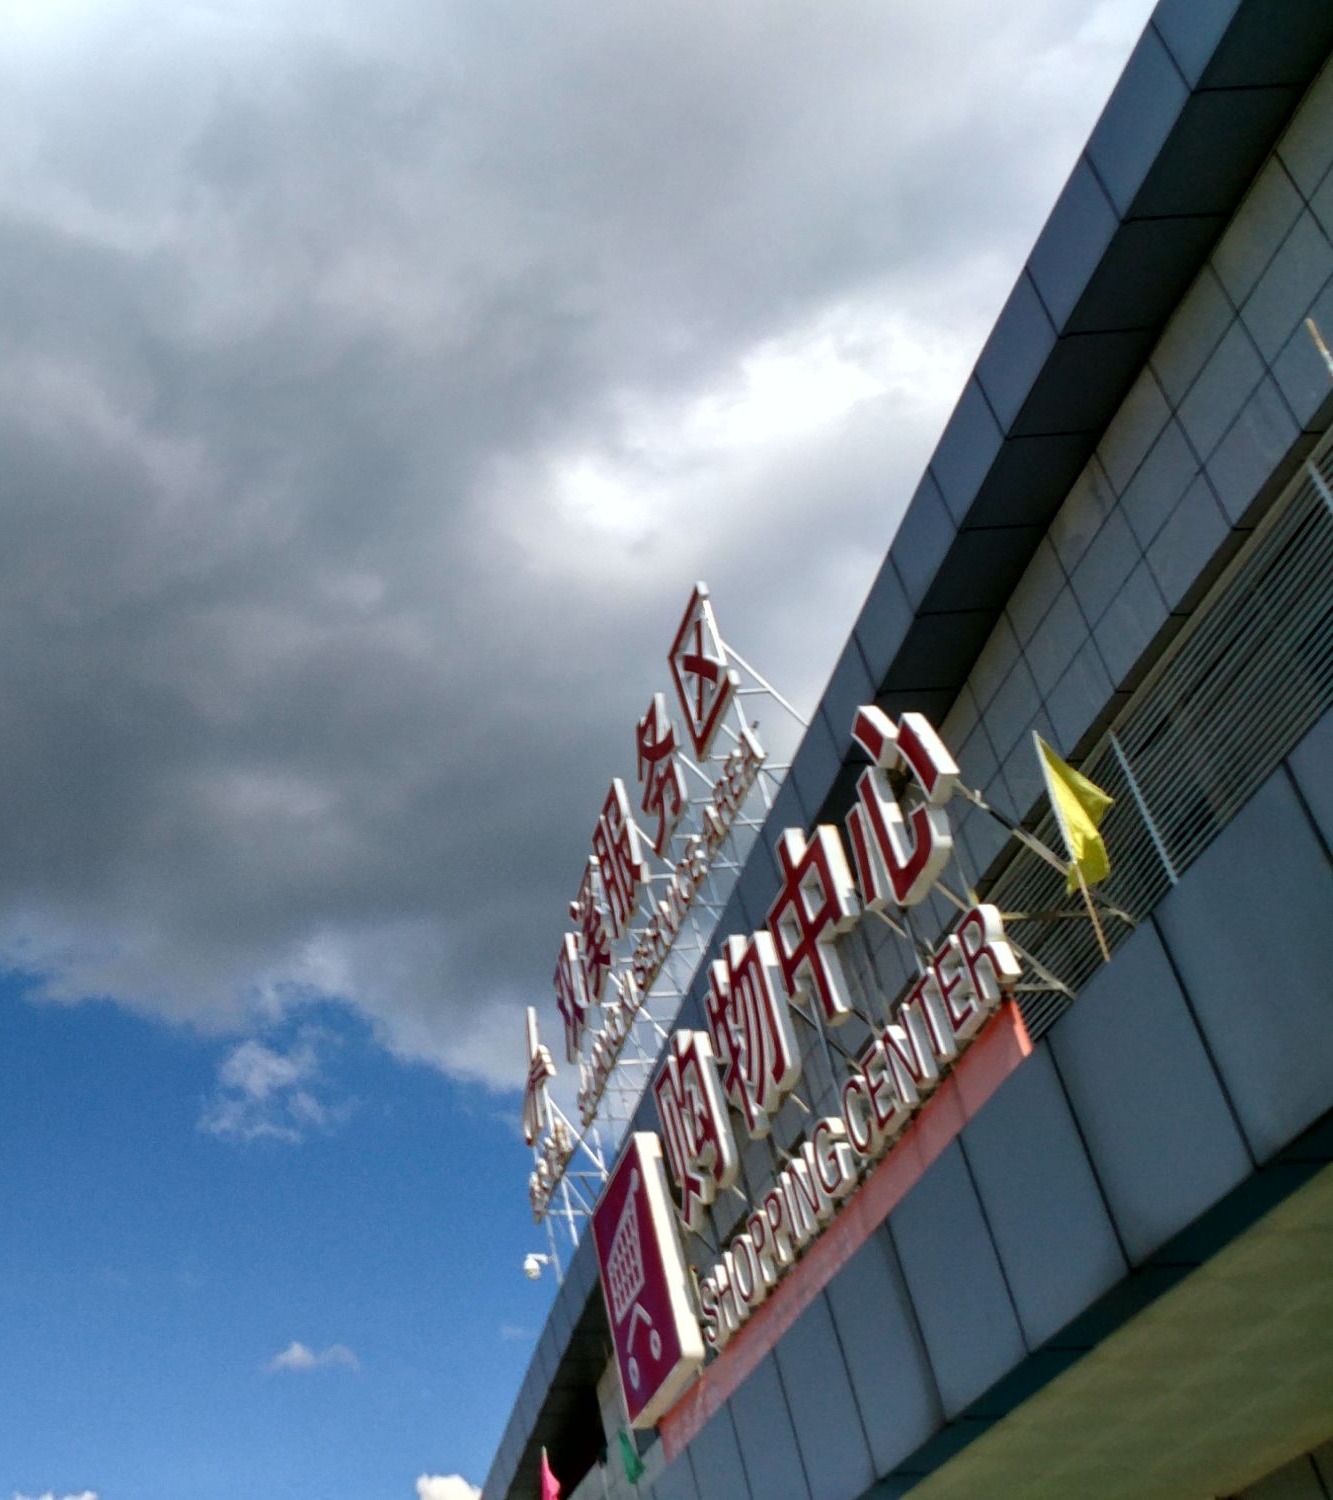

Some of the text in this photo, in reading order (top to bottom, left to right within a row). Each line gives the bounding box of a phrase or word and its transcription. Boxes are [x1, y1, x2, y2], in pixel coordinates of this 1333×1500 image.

[655, 705, 960, 1230] 购物中心
[698, 1117, 857, 1351] SHOPPING
[842, 904, 1022, 1157] CENTER
